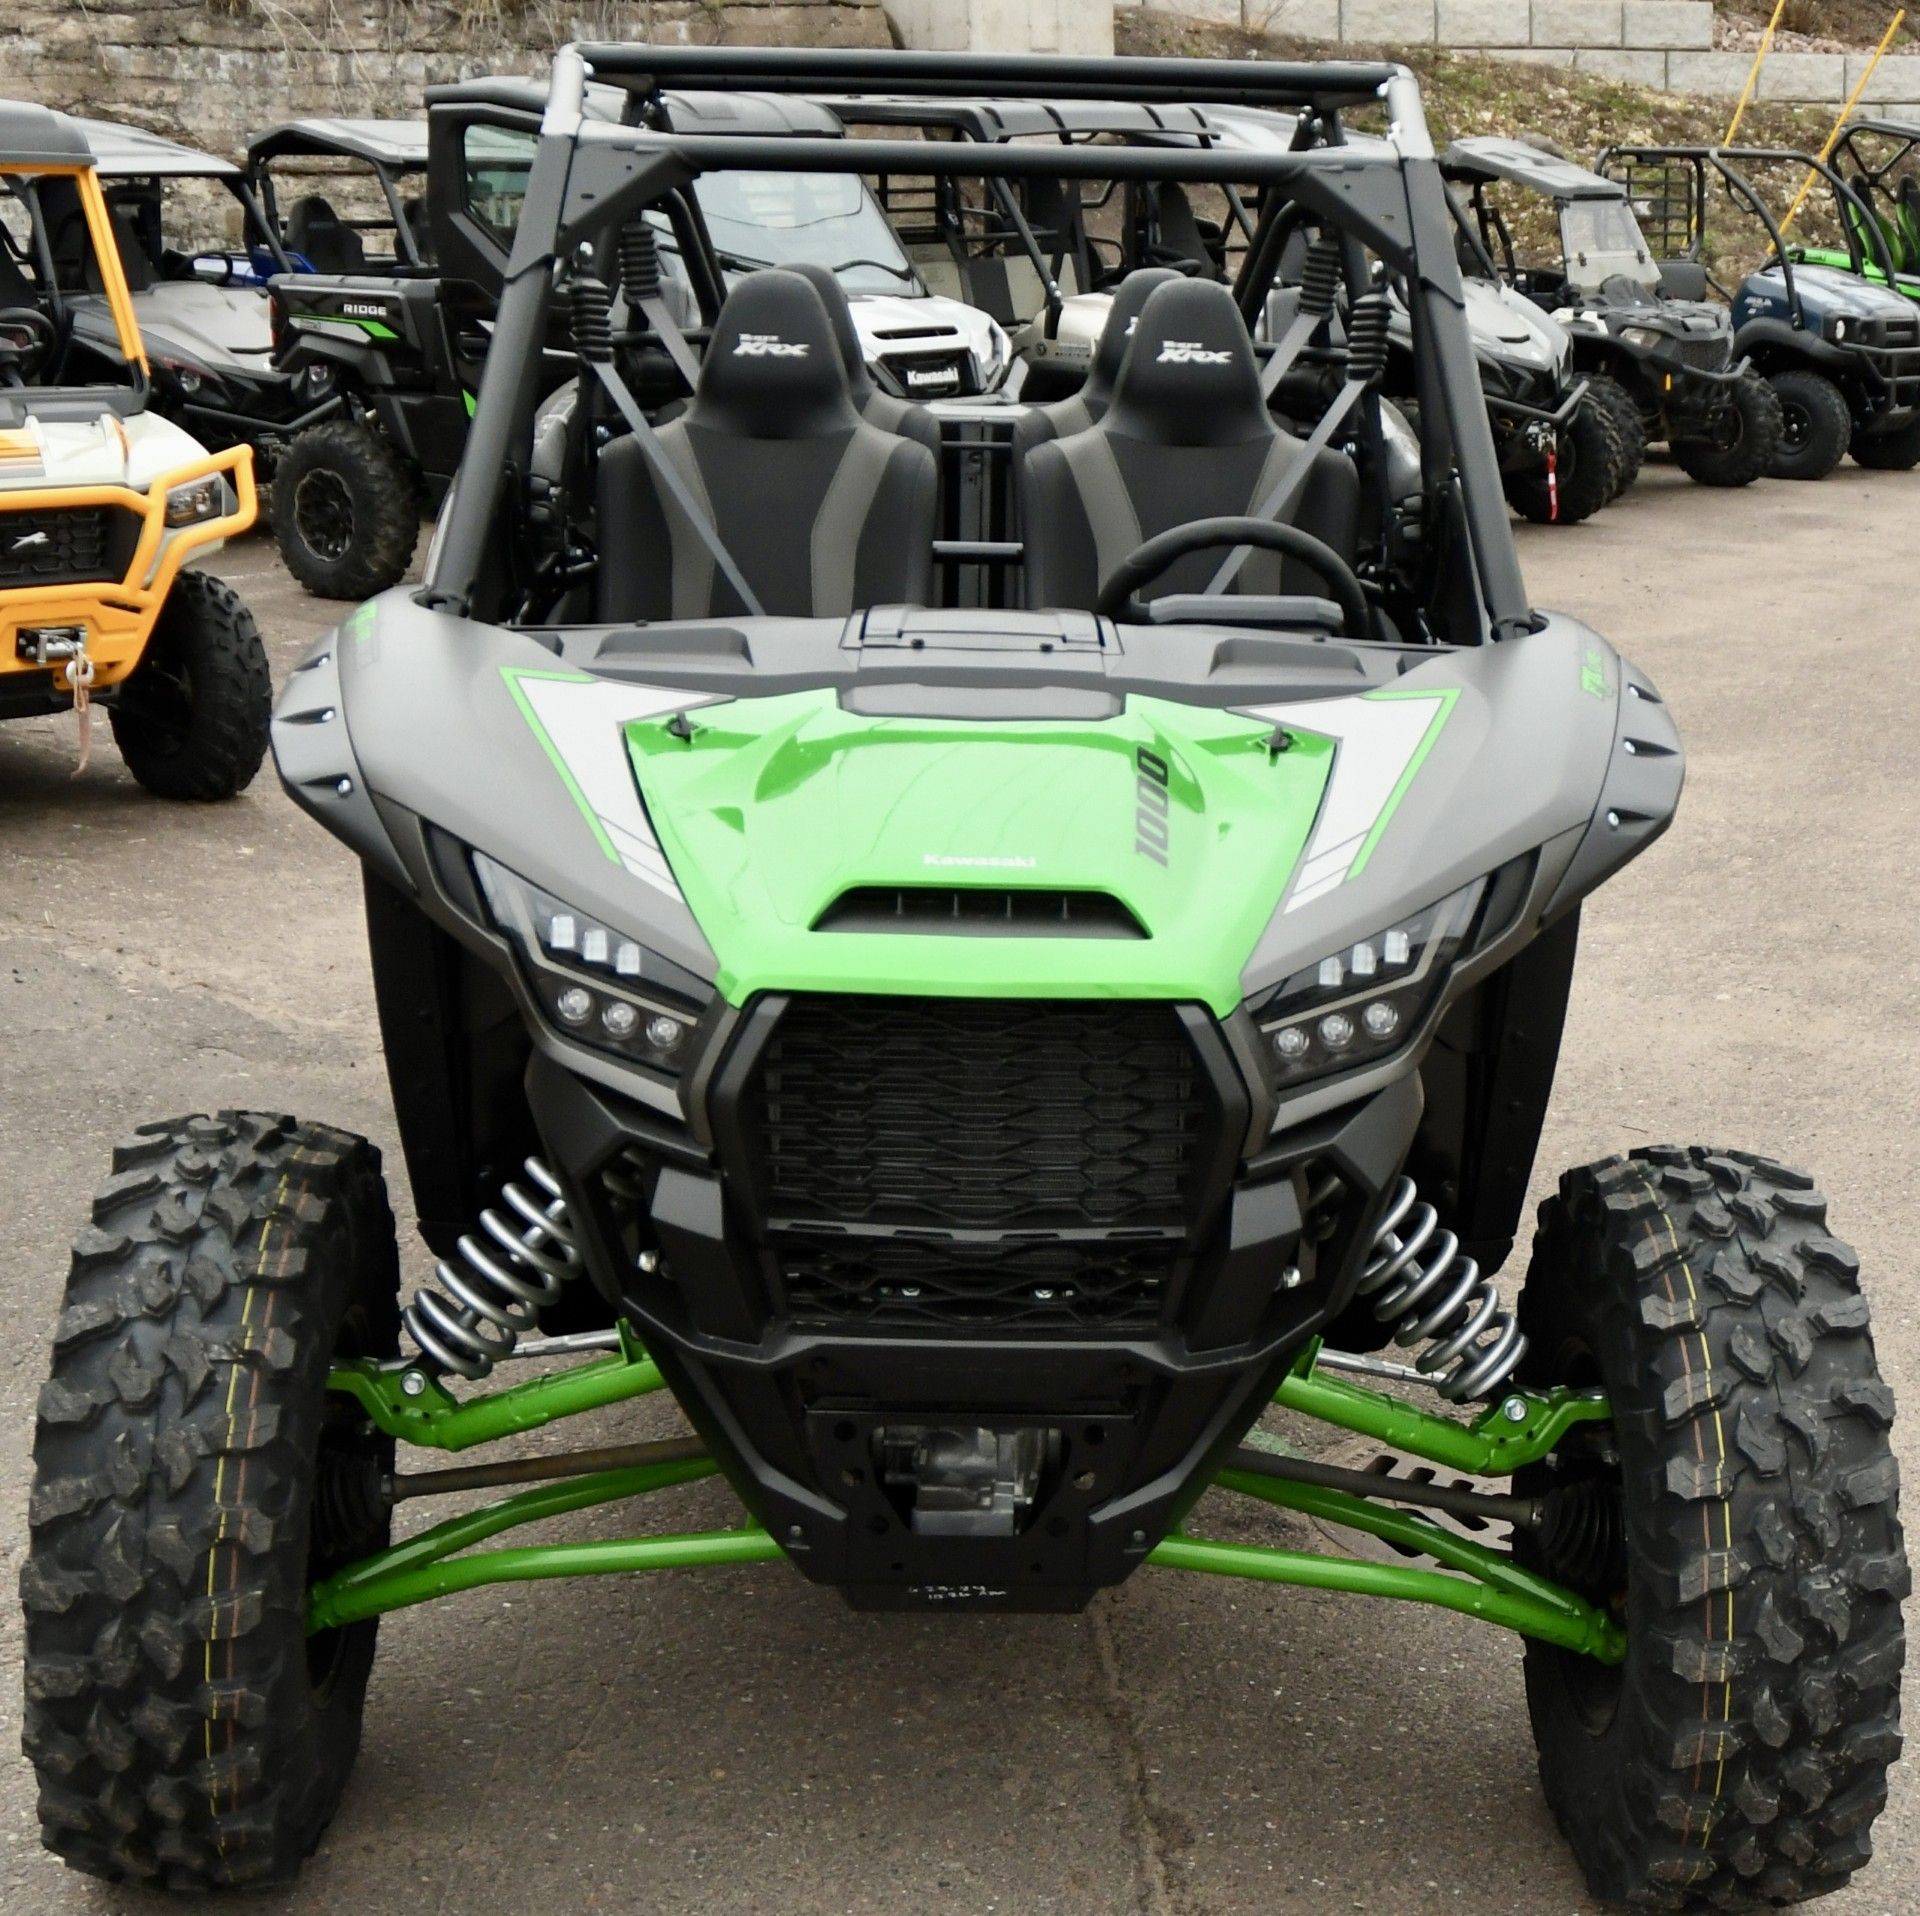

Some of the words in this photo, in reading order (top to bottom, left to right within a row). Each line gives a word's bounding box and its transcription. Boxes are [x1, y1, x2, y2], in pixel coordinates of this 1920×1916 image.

[343, 303, 388, 317] RIDGE
[906, 366, 959, 385] Kawasaki
[1135, 744, 1169, 867] 1000
[923, 852, 1037, 868] Kawasaki
